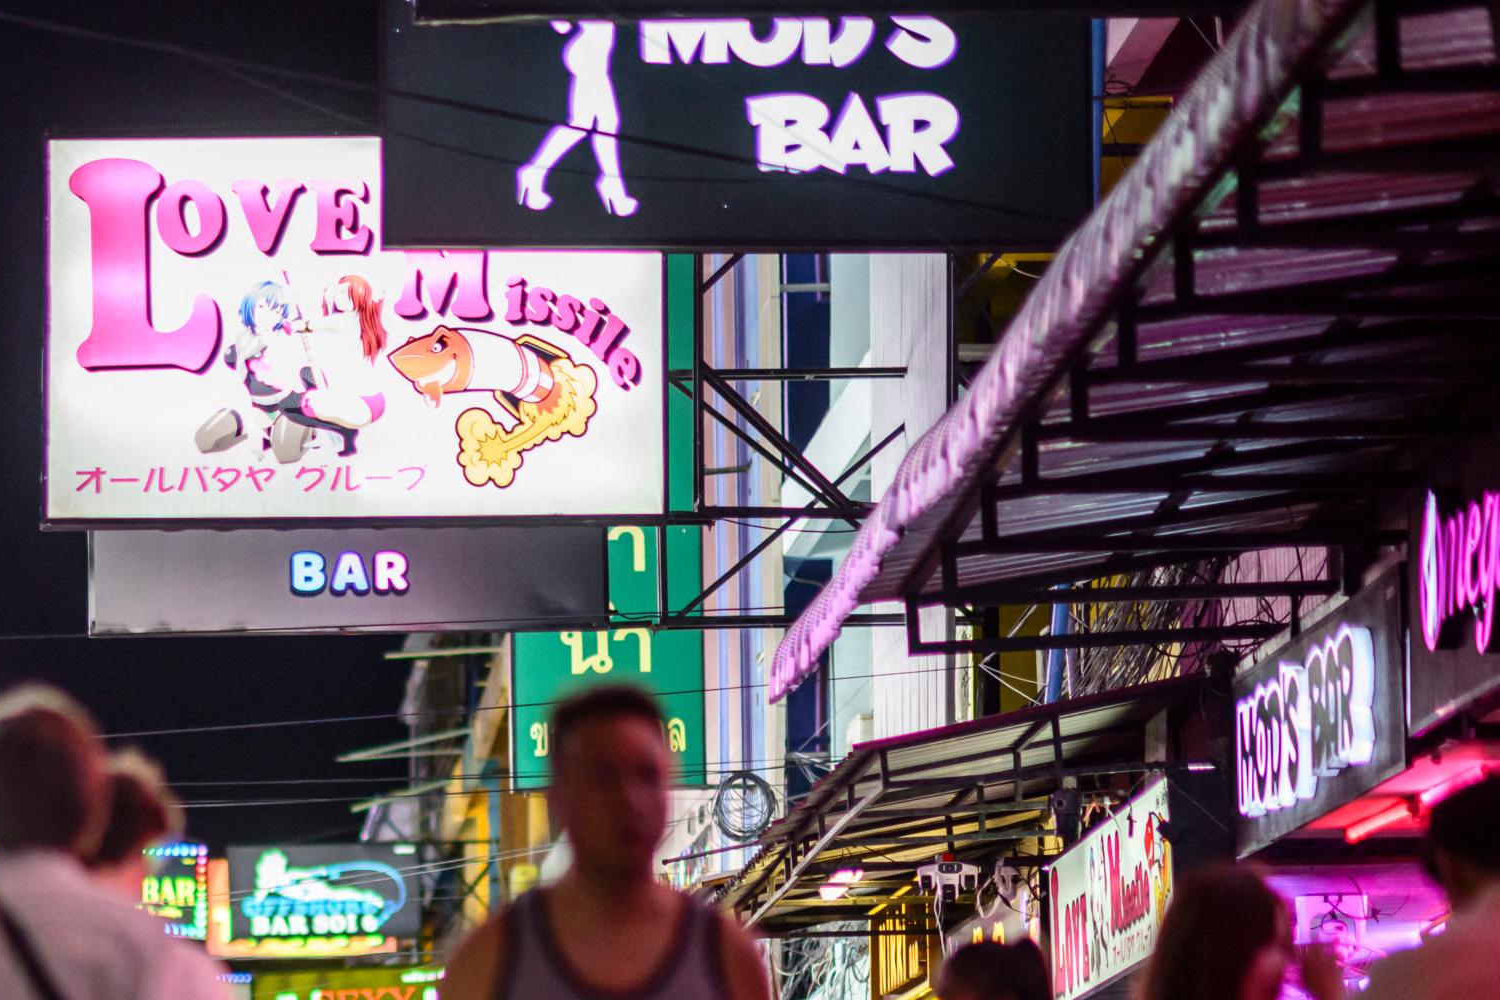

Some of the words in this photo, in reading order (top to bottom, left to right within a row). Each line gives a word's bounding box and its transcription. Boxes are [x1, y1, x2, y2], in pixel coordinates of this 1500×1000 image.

[639, 17, 957, 68] MODS
[746, 92, 961, 176] BAR
[289, 549, 409, 598] BAR
[1304, 624, 1374, 778] BAR
[141, 875, 196, 907] BAR
[252, 914, 309, 936] BAR
[312, 914, 359, 935] SOI
[1050, 865, 1091, 1000] LOVE
